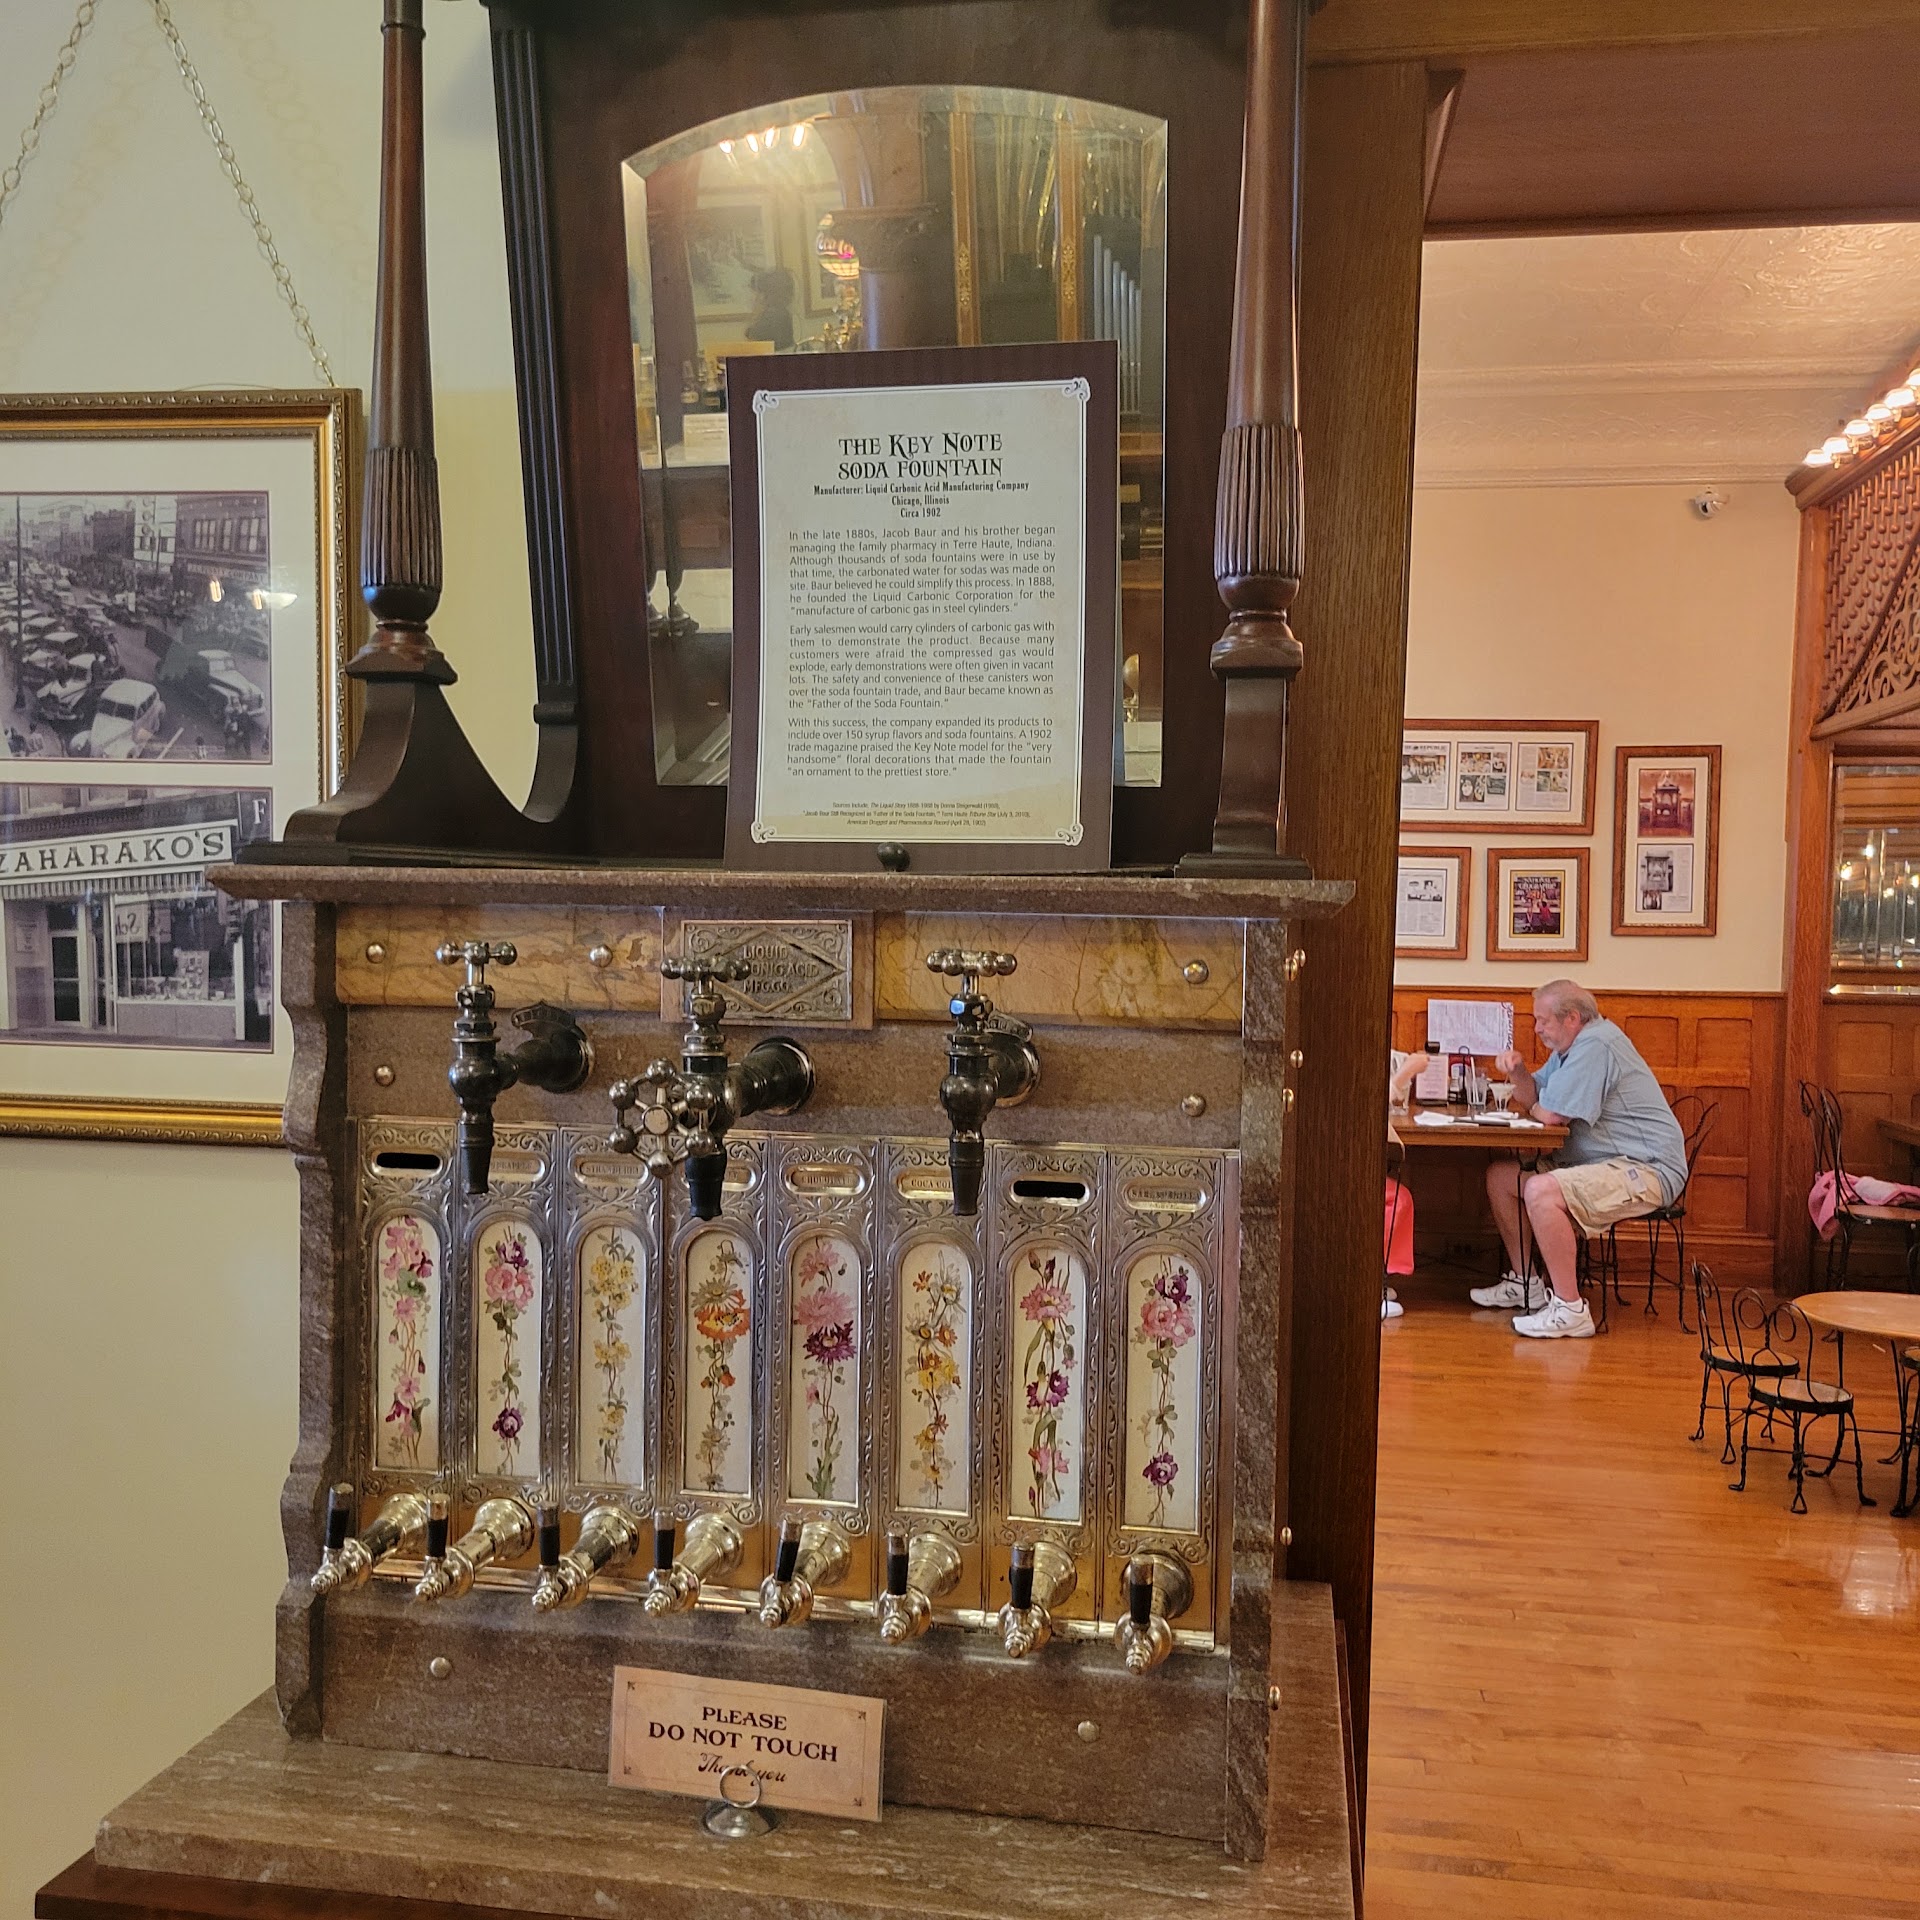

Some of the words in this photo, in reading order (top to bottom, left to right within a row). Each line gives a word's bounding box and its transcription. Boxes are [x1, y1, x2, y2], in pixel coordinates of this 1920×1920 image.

[839, 437, 881, 456] THE
[889, 434, 933, 459] KEY
[942, 432, 1003, 457] NOTE
[838, 461, 889, 480] SODA
[898, 458, 1003, 478] FOUNTAIN
[865, 483, 887, 496] Liquid
[889, 482, 921, 493] Carbonic
[924, 481, 940, 492] Acid
[942, 480, 993, 494] Manufacturing
[996, 479, 1029, 493] Company
[924, 493, 949, 504] Illinois
[900, 507, 919, 518] Circa
[922, 507, 940, 517] 1902
[789, 531, 798, 540] In
[803, 530, 818, 539] the
[822, 530, 840, 539] late
[883, 528, 909, 537] Jacob
[914, 528, 936, 537] Baur
[941, 527, 959, 536] and
[964, 527, 978, 536] his
[982, 526, 1019, 535] brother
[1024, 525, 1055, 537] began
[789, 542, 835, 555] managing
[839, 542, 854, 551] the
[858, 541, 886, 554] family
[890, 540, 936, 553] pharmacy
[940, 540, 949, 549] in
[954, 539, 977, 548] Terre
[789, 555, 833, 568] Although
[837, 554, 885, 564] thousands
[889, 554, 899, 563] of
[904, 553, 926, 562] soda
[931, 552, 976, 562] fountains
[1009, 551, 1017, 560] in
[1043, 550, 1055, 562] by
[857, 605, 866, 614] of
[870, 604, 910, 614] carbonic
[913, 606, 929, 616] gas
[932, 604, 940, 613] in
[943, 604, 965, 613] steel
[789, 625, 811, 637] Early
[814, 624, 855, 633] salesmen
[858, 624, 887, 633] would
[890, 625, 912, 635] carry
[915, 623, 955, 635] cylinders
[958, 623, 967, 631] of
[971, 622, 1011, 631] carbonic
[1014, 624, 1030, 634] gas
[1033, 621, 1054, 630] with
[789, 637, 814, 646] them
[821, 637, 831, 646] to
[837, 636, 900, 646] demonstrate
[907, 636, 923, 645] the
[979, 635, 1020, 644] Because
[1026, 636, 1054, 647] many
[789, 649, 839, 659] customers
[875, 649, 904, 658] afraid
[911, 649, 926, 657] the
[933, 648, 992, 660] compressed
[999, 650, 1016, 659] gas
[1022, 647, 1053, 656] would
[830, 662, 852, 674] early
[855, 661, 926, 670] demonstrations
[954, 660, 980, 669] often
[983, 660, 1008, 672] given
[1011, 660, 1019, 669] in
[1022, 660, 1054, 669] vacant
[813, 674, 828, 683] The
[832, 674, 859, 686] safety
[863, 674, 880, 683] and
[883, 673, 941, 683] convenience
[945, 673, 954, 682] of
[959, 673, 984, 682] these
[987, 673, 1028, 682] canisters
[788, 699, 803, 708] the
[843, 699, 852, 708] of
[856, 699, 871, 708] the
[874, 699, 896, 708] Soda
[787, 718, 810, 727] With
[813, 718, 829, 726] this
[872, 717, 887, 726] the
[889, 719, 932, 729] company
[935, 717, 981, 729] expanded
[984, 717, 994, 726] its
[997, 717, 1039, 729] products
[1042, 717, 1052, 726] to
[846, 755, 870, 764] floral
[874, 755, 930, 764] decorations
[934, 755, 954, 763] that
[958, 755, 985, 763] made
[989, 755, 1005, 763] the
[1010, 755, 1051, 763] fountain
[806, 767, 851, 776] ornament
[854, 767, 863, 776] to
[867, 767, 881, 776] the
[884, 767, 922, 779] prettiest
[0, 831, 224, 873] ZAHARAKO'S
[744, 945, 788, 959] LIQUID
[751, 962, 784, 977] ONIC
[911, 1179, 934, 1188] COCA
[702, 1706, 787, 1731] PLEASE
[648, 1721, 685, 1741] DO
[692, 1728, 743, 1748] NOT
[751, 1735, 838, 1763] TOUCH
